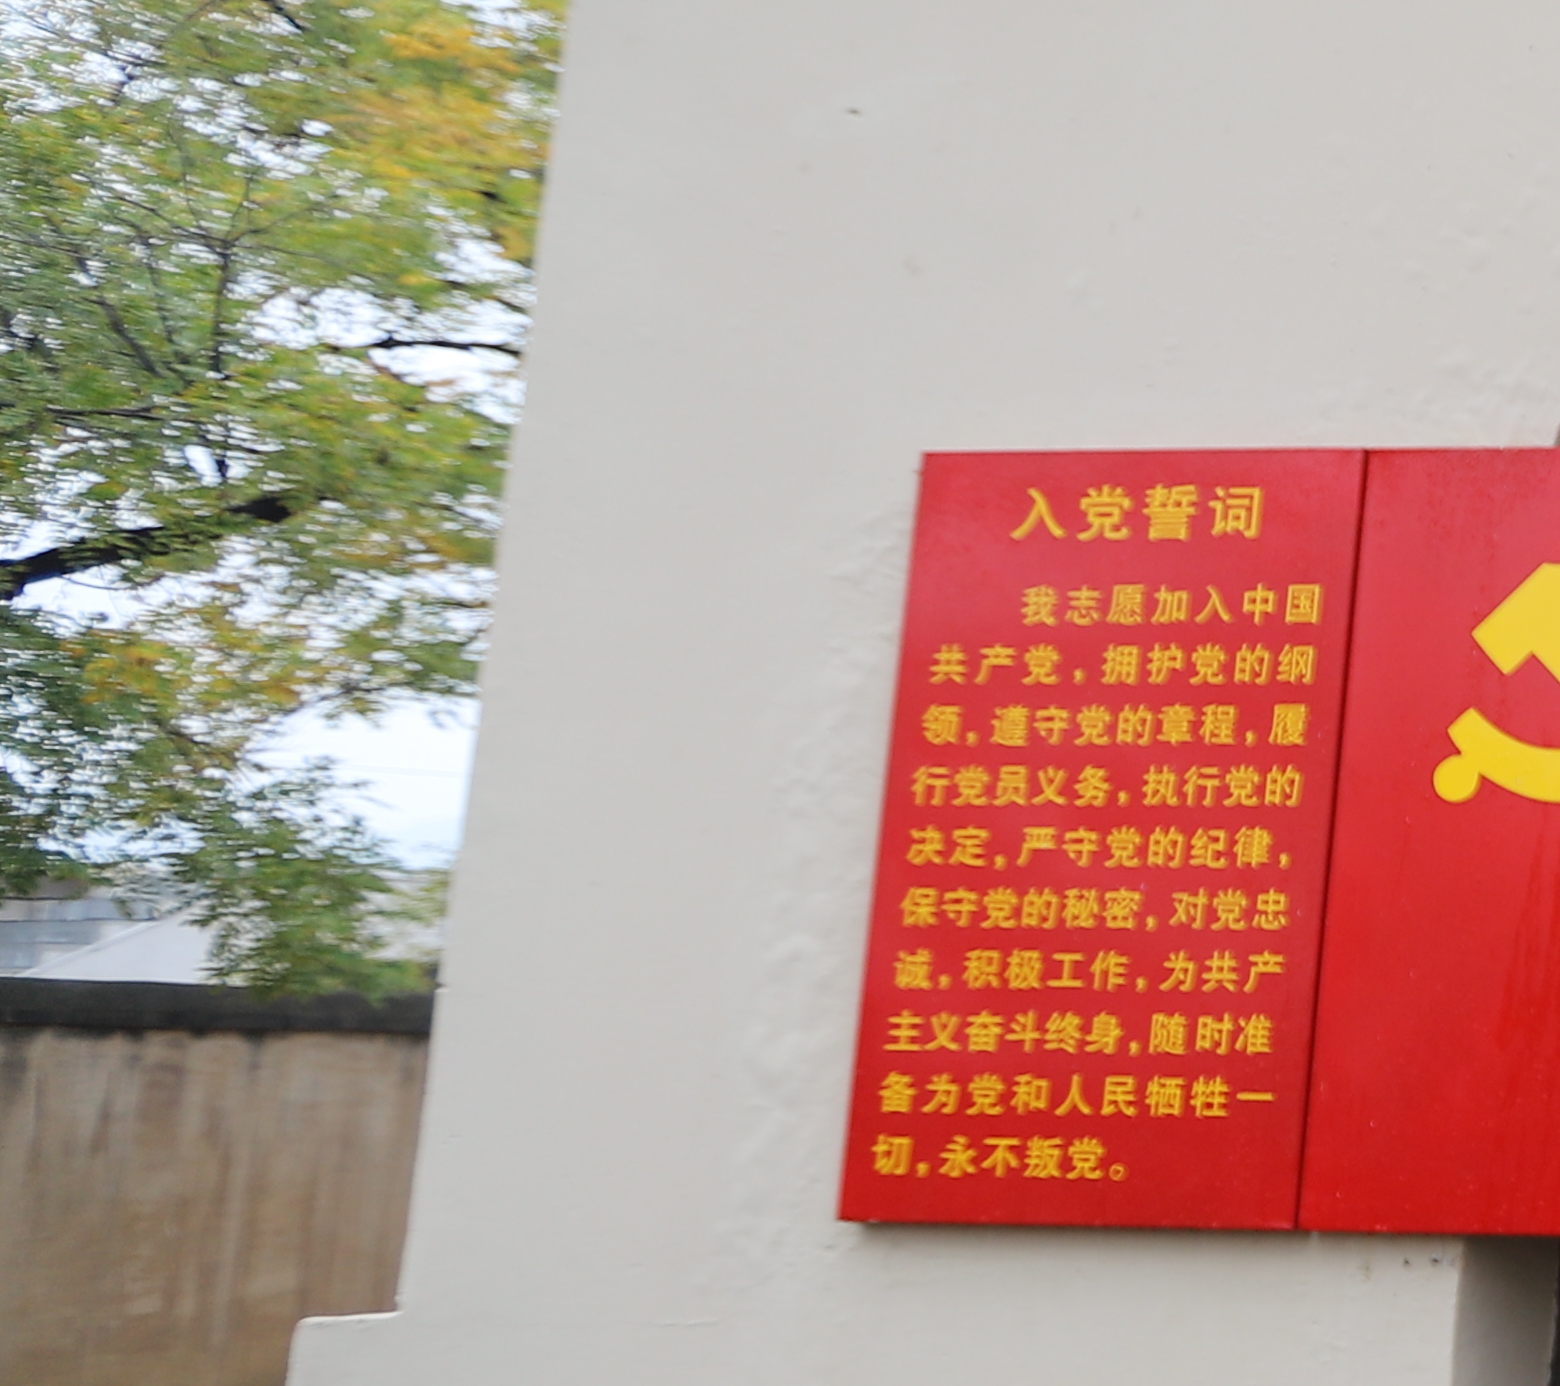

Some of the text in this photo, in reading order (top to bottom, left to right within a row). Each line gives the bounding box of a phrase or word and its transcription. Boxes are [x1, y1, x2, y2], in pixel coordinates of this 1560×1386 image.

[1010, 484, 1264, 541] 入党誓词
[1020, 583, 1323, 626] 我志愿加入中国
[929, 643, 1316, 686] 共产党，拥护党的纲
[920, 703, 1308, 747] 领，遵守党的章程，履
[910, 763, 1303, 808] 行党员义务，执行党的
[906, 825, 1292, 870] 决定，严守党的纪律，
[899, 887, 1290, 930] 保守党的秘密，对党忠
[893, 948, 1286, 993] 诚，积极工作，为共产
[883, 1010, 1273, 1055] 主义奋斗终身，随时准
[877, 1072, 1274, 1117] 备为党和人民牺牲一
[871, 1134, 1128, 1181] 切，永不叛党。
